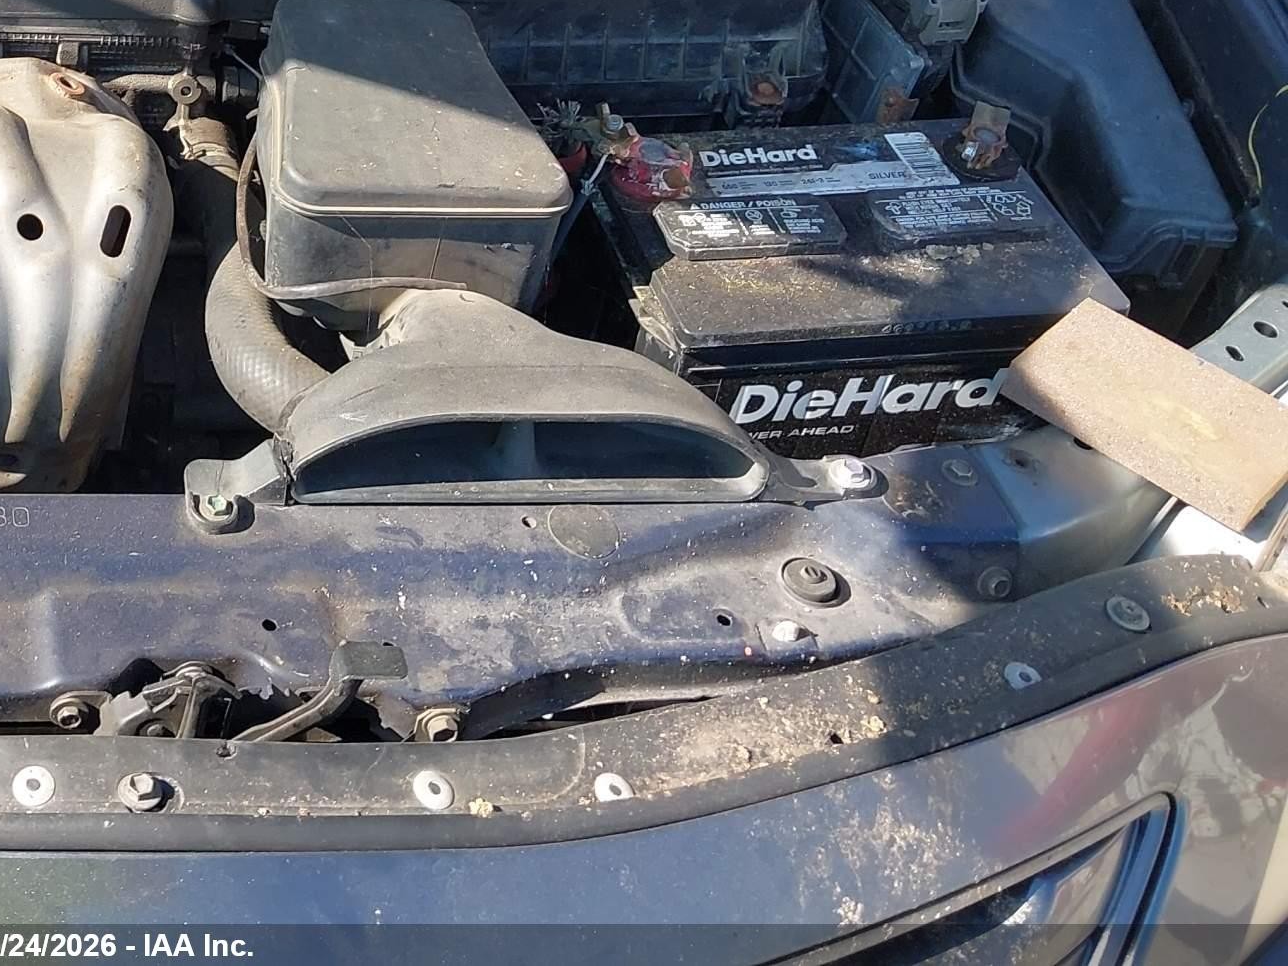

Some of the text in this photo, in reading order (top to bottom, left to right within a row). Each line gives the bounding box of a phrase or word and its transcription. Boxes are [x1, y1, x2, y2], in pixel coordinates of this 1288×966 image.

[699, 144, 818, 168] DieHard
[868, 171, 906, 181] SILVER
[700, 200, 745, 210] DANGER
[756, 198, 796, 208] POISON
[728, 368, 1009, 425] DieHard
[787, 425, 854, 437] AHEAD
